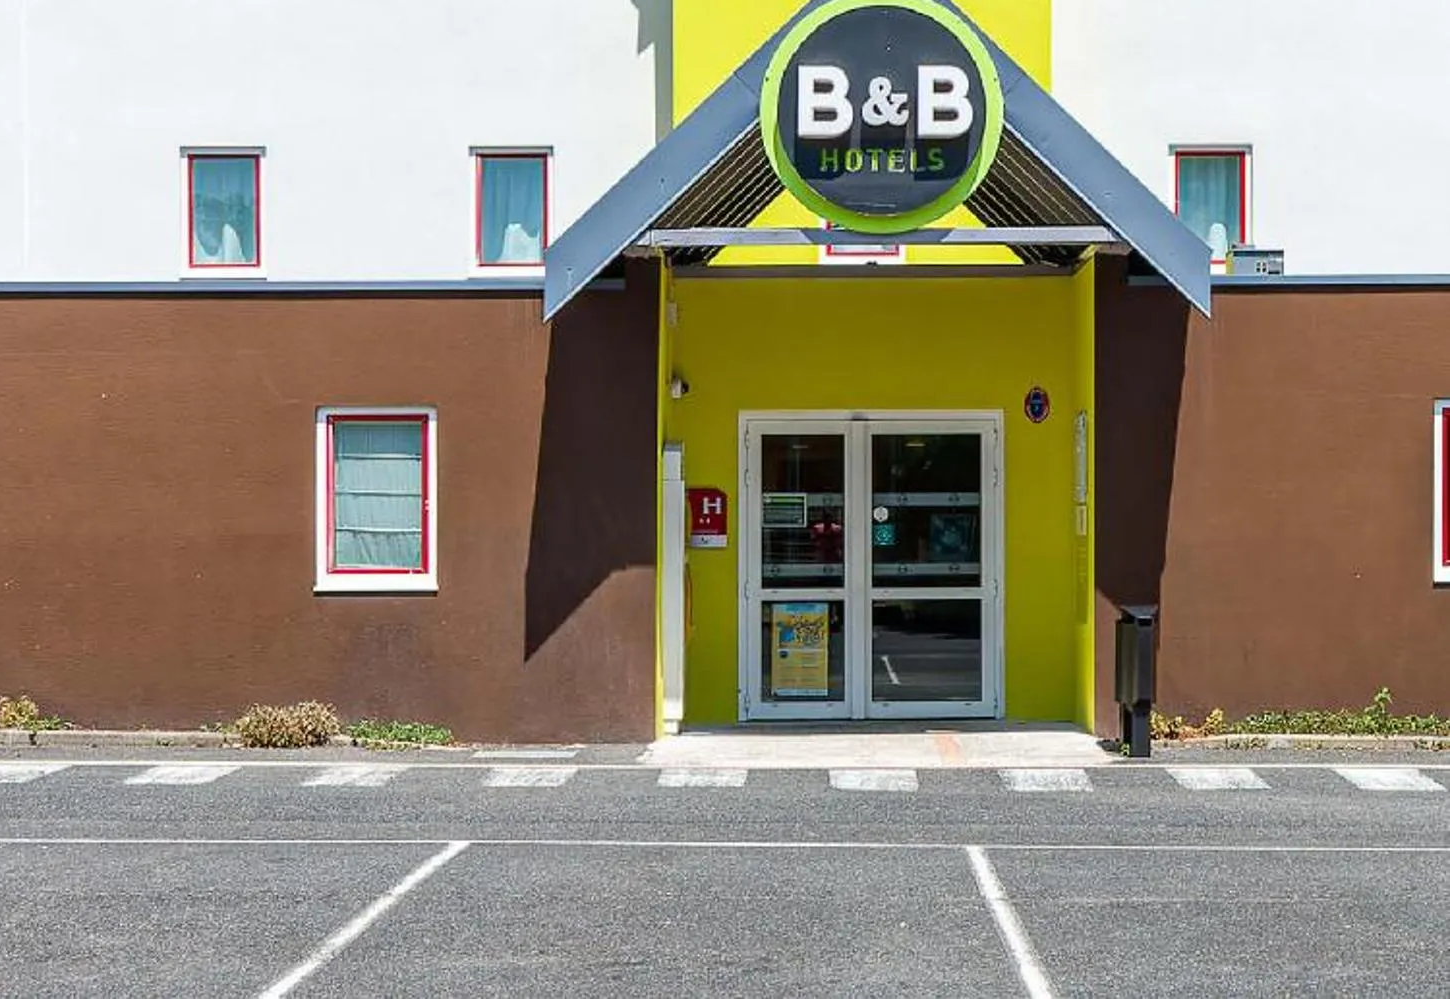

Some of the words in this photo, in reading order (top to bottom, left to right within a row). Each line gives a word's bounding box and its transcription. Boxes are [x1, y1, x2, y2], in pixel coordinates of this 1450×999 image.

[798, 65, 973, 138] B&B
[819, 149, 945, 172] HOTELS
[703, 497, 721, 514] H
